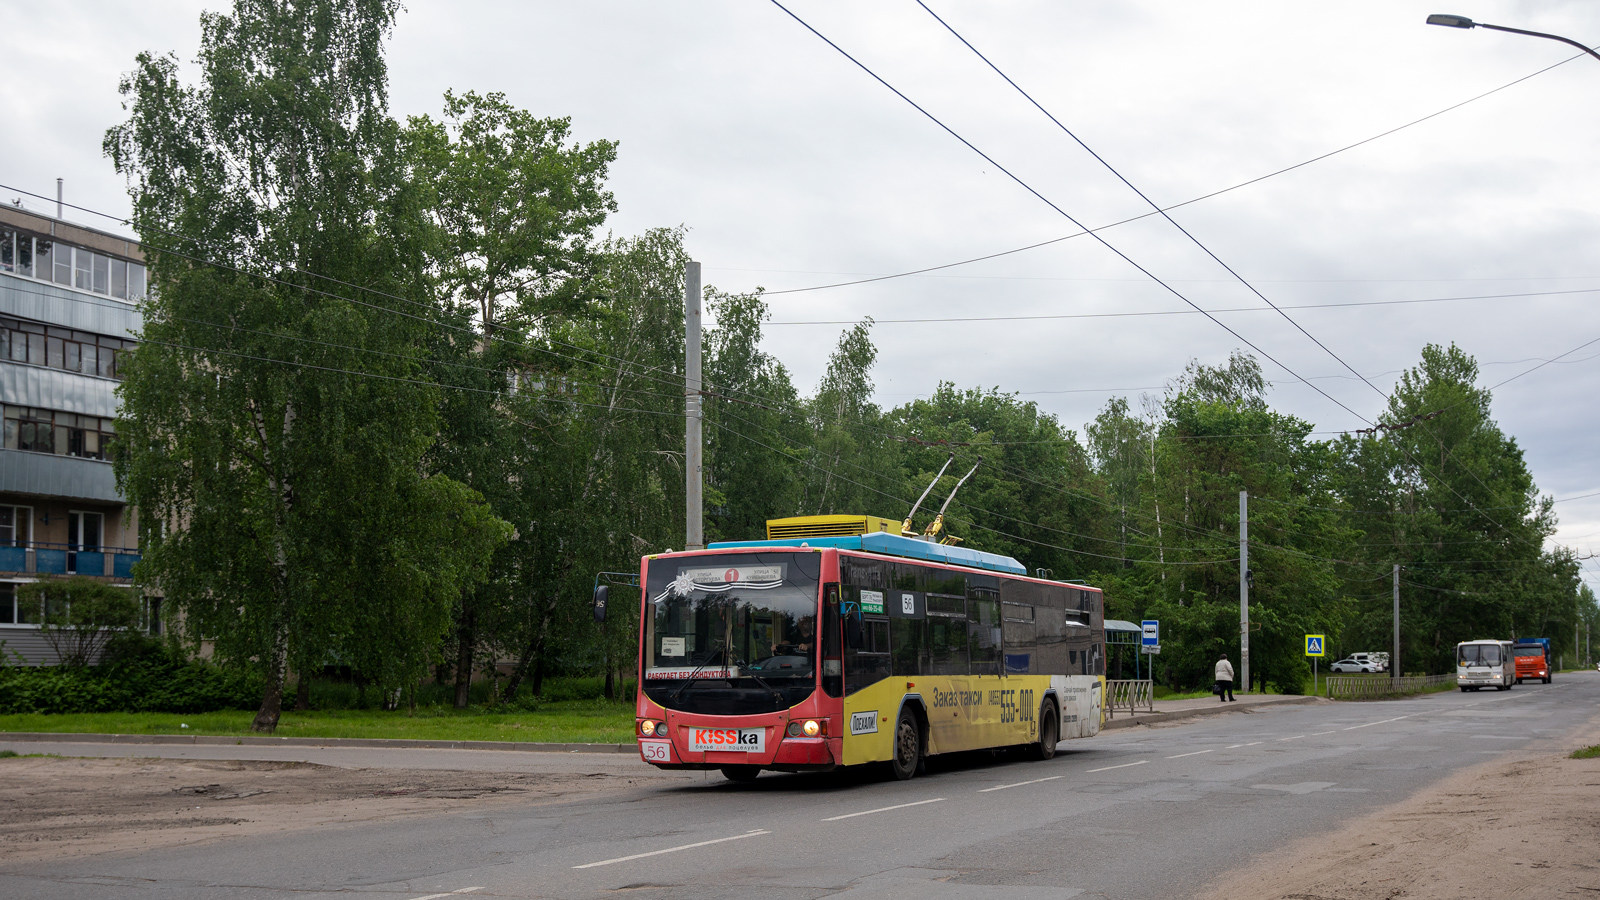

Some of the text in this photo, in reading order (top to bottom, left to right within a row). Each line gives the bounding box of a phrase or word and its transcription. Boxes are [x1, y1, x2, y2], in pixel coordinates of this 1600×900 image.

[904, 597, 913, 610] 56
[647, 671, 677, 680] РАБОТАЕТ
[678, 671, 690, 679] БЕЗ
[933, 686, 958, 708] Заказ
[959, 690, 982, 706] такси
[647, 746, 666, 759] 56
